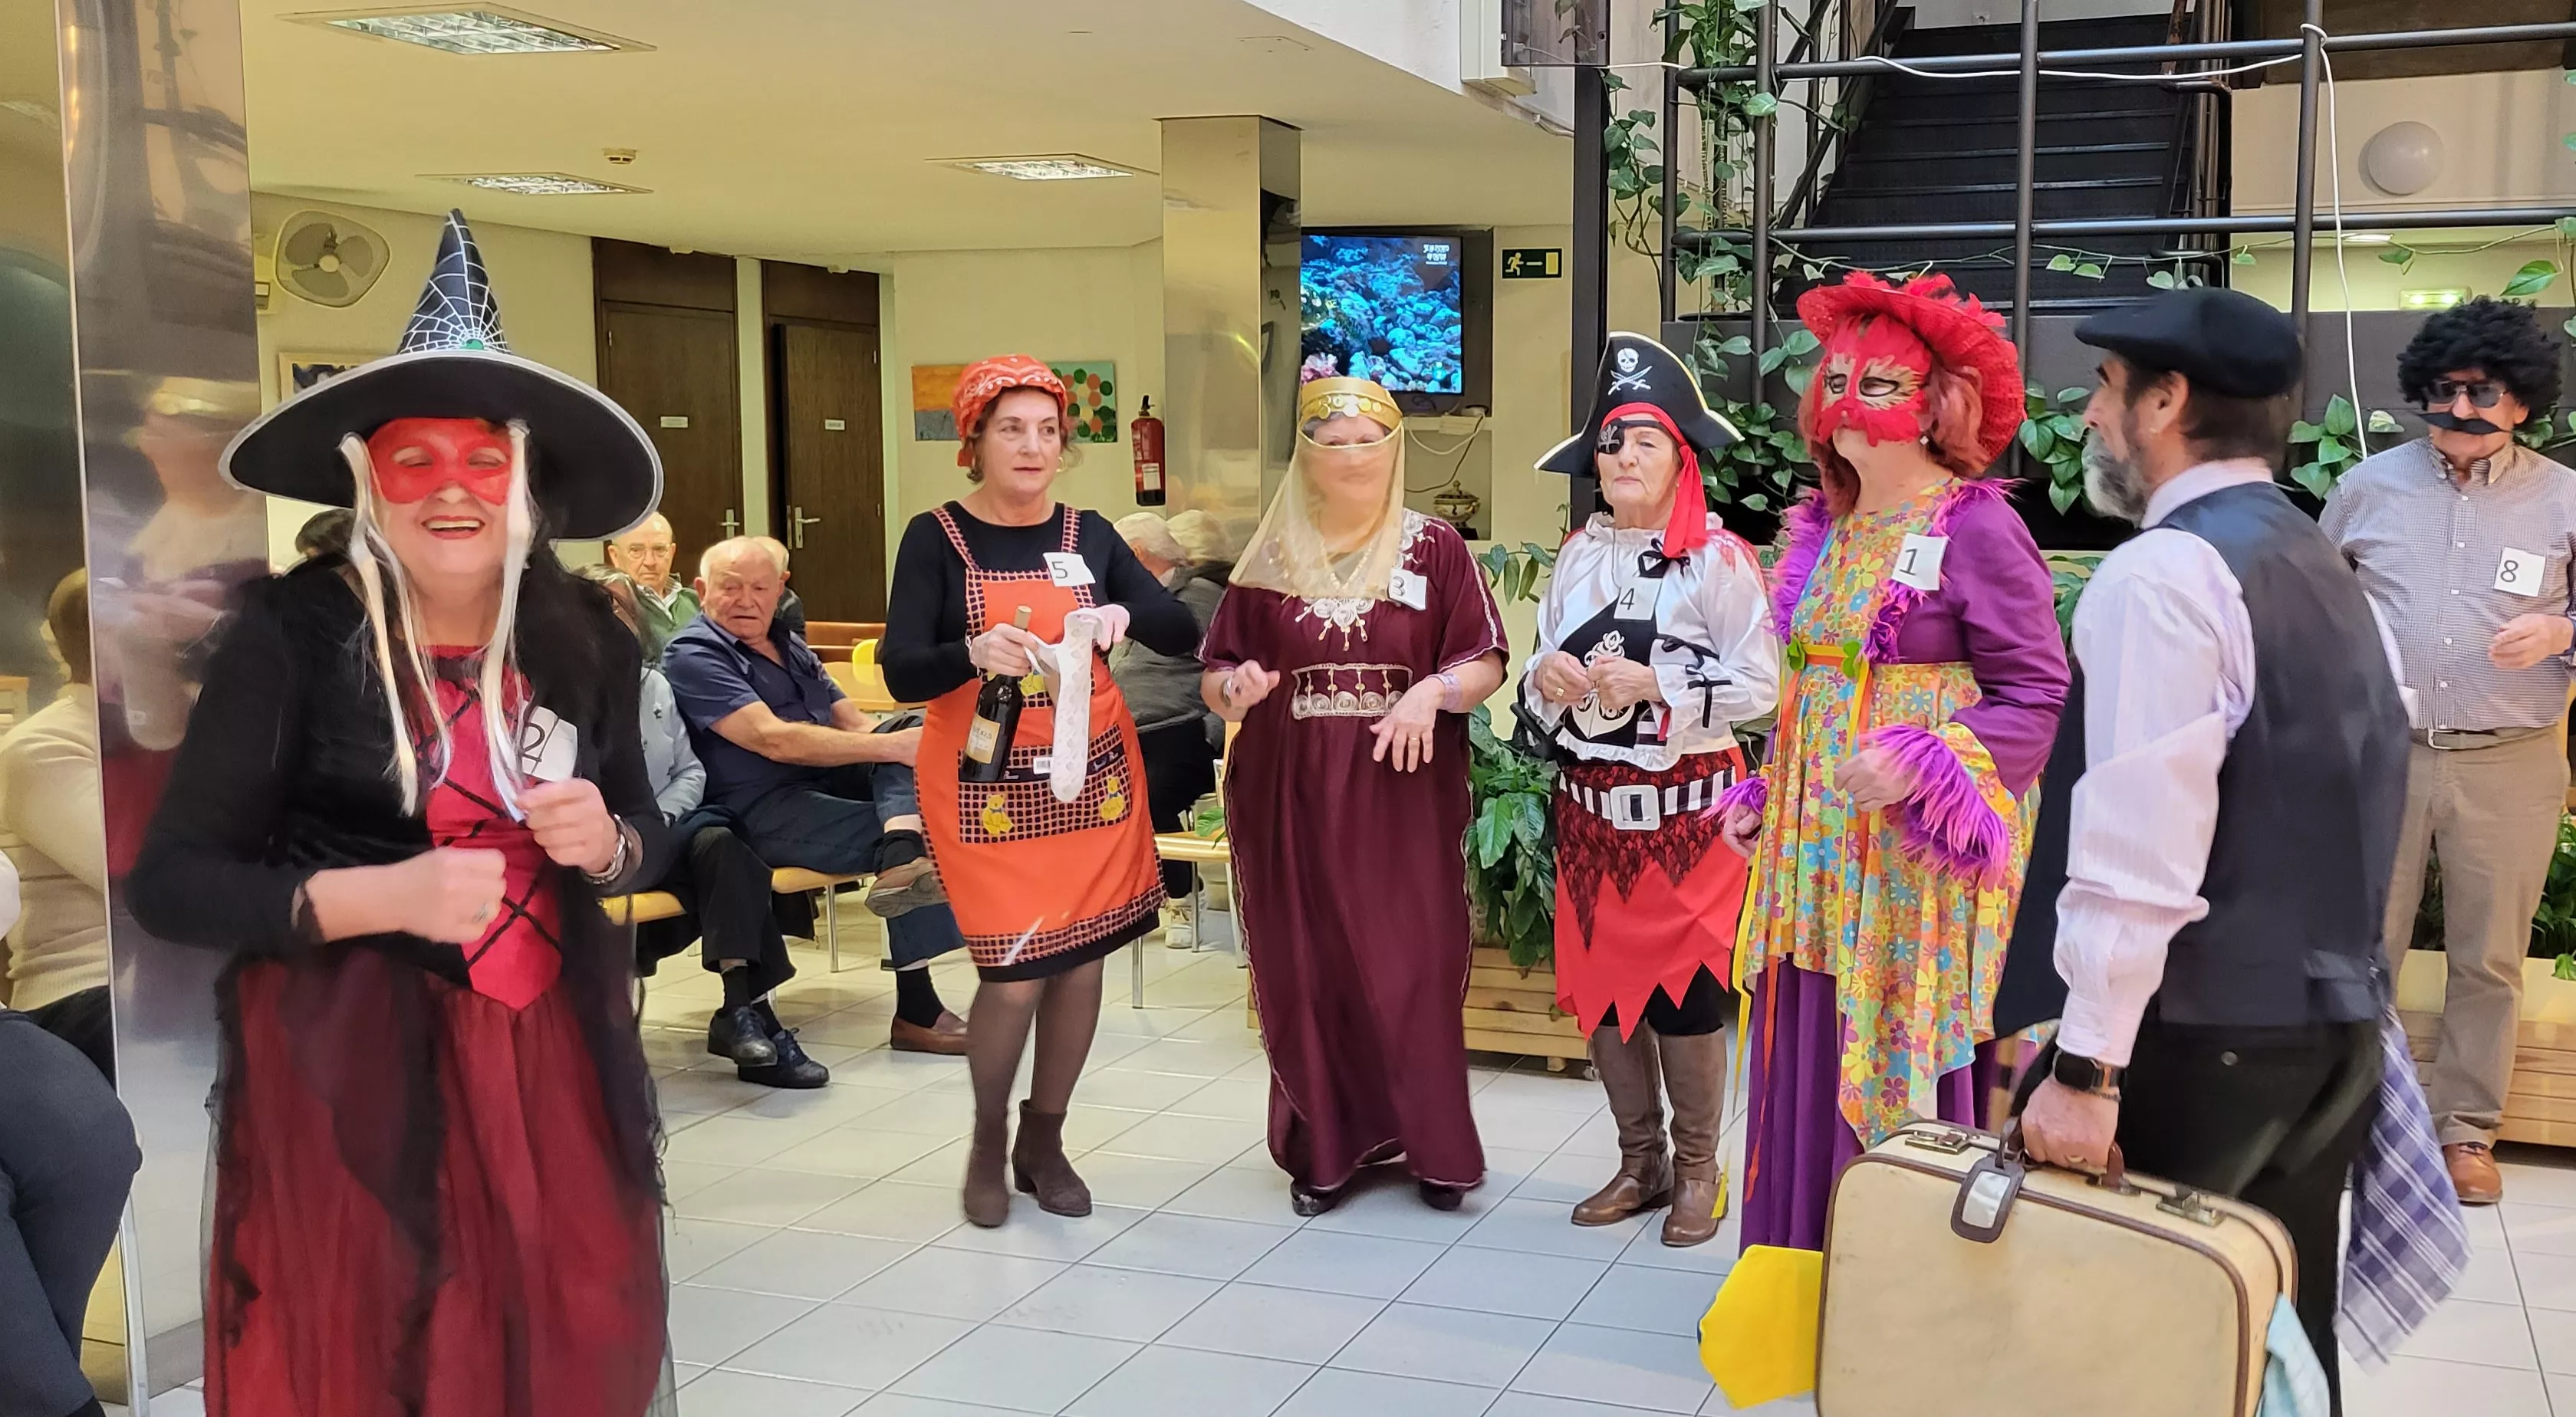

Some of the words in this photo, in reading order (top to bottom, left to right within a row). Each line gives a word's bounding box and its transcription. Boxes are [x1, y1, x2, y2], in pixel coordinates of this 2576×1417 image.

[1051, 561, 1068, 579] 5
[1898, 547, 1918, 576] 1
[2500, 559, 2518, 583] 8
[1392, 575, 1406, 597] 3
[1620, 587, 1634, 610] 4
[519, 722, 545, 763] 2
